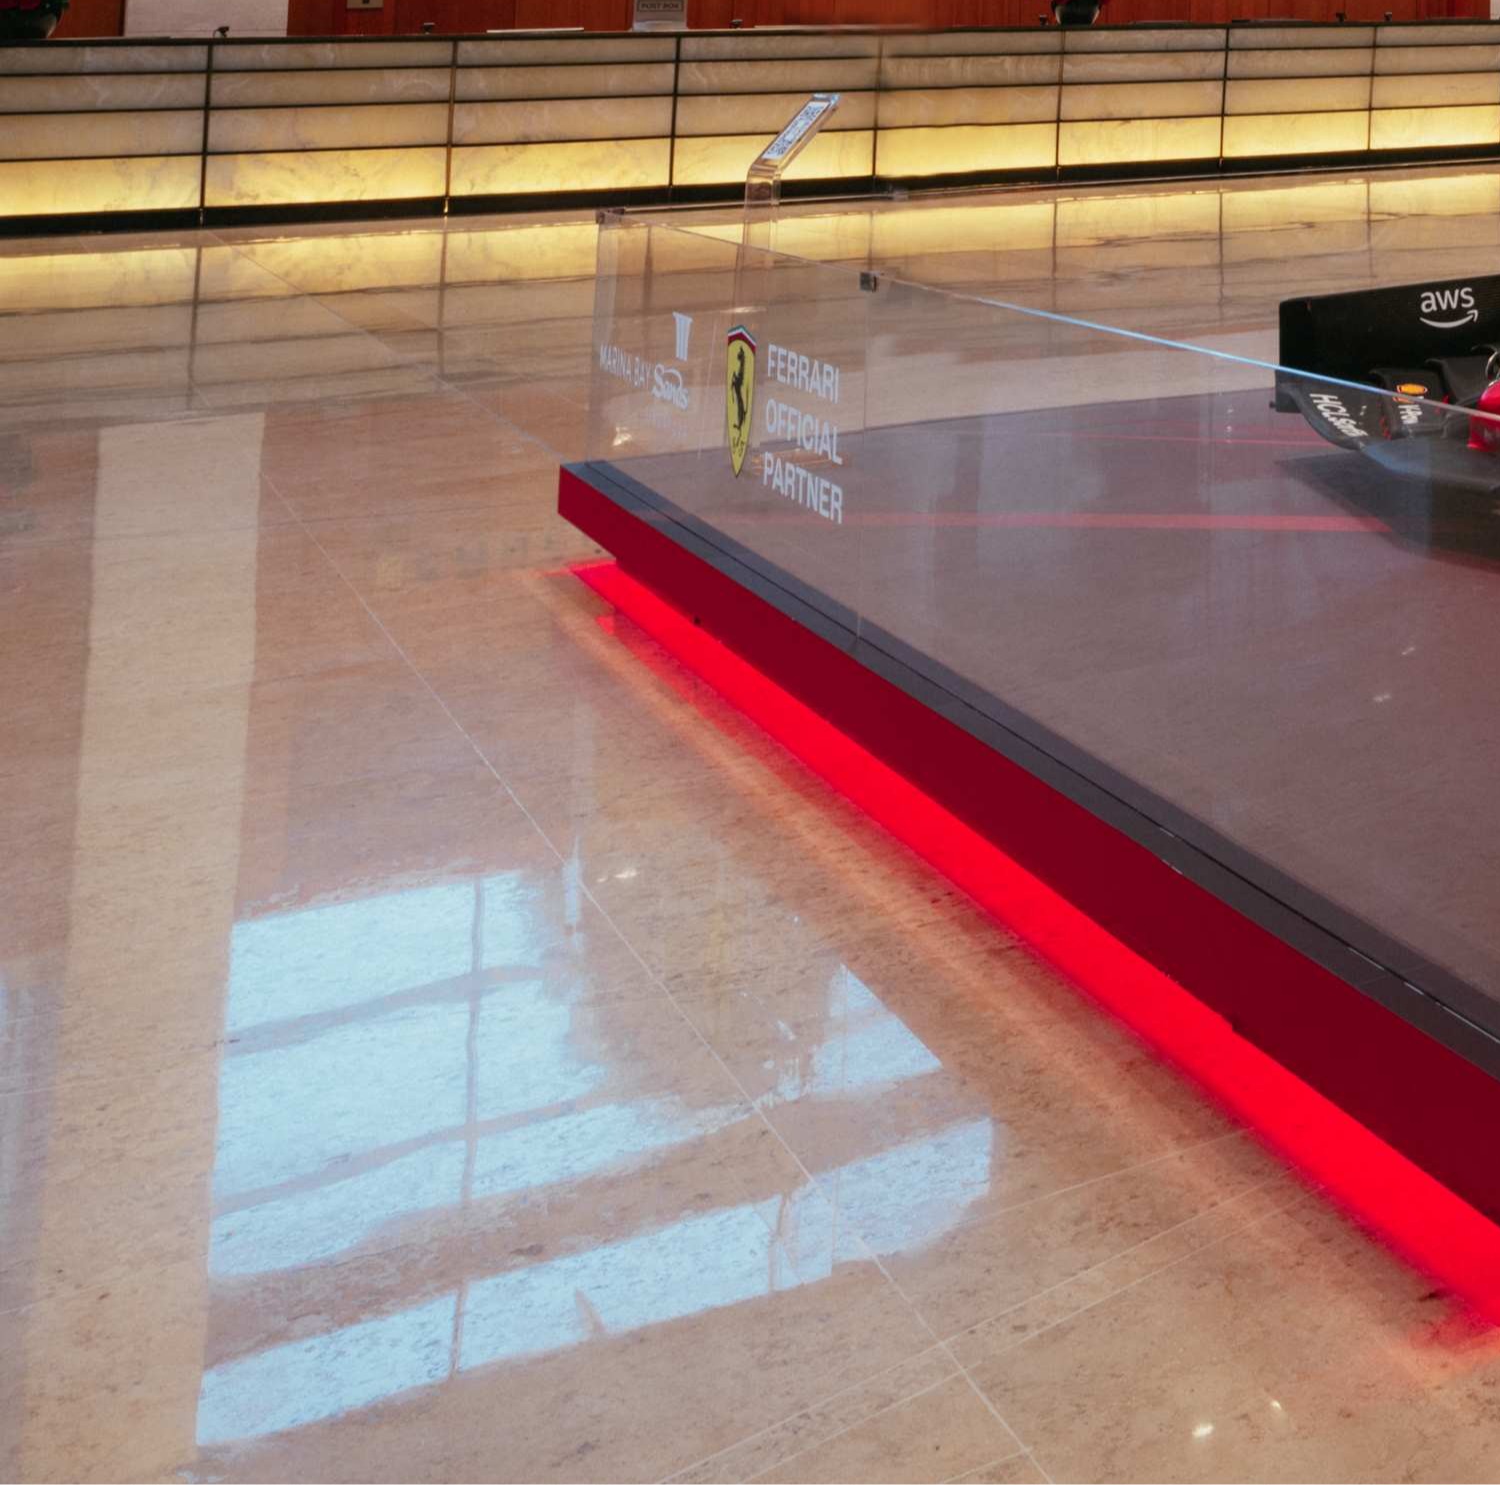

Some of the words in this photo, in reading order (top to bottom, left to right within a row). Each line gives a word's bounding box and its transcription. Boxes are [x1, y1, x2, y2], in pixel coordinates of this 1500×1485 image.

[1421, 287, 1475, 313] aws
[767, 343, 840, 404] FERRARI
[765, 398, 843, 466] OFFICIAL
[763, 451, 843, 525] PARTNER
